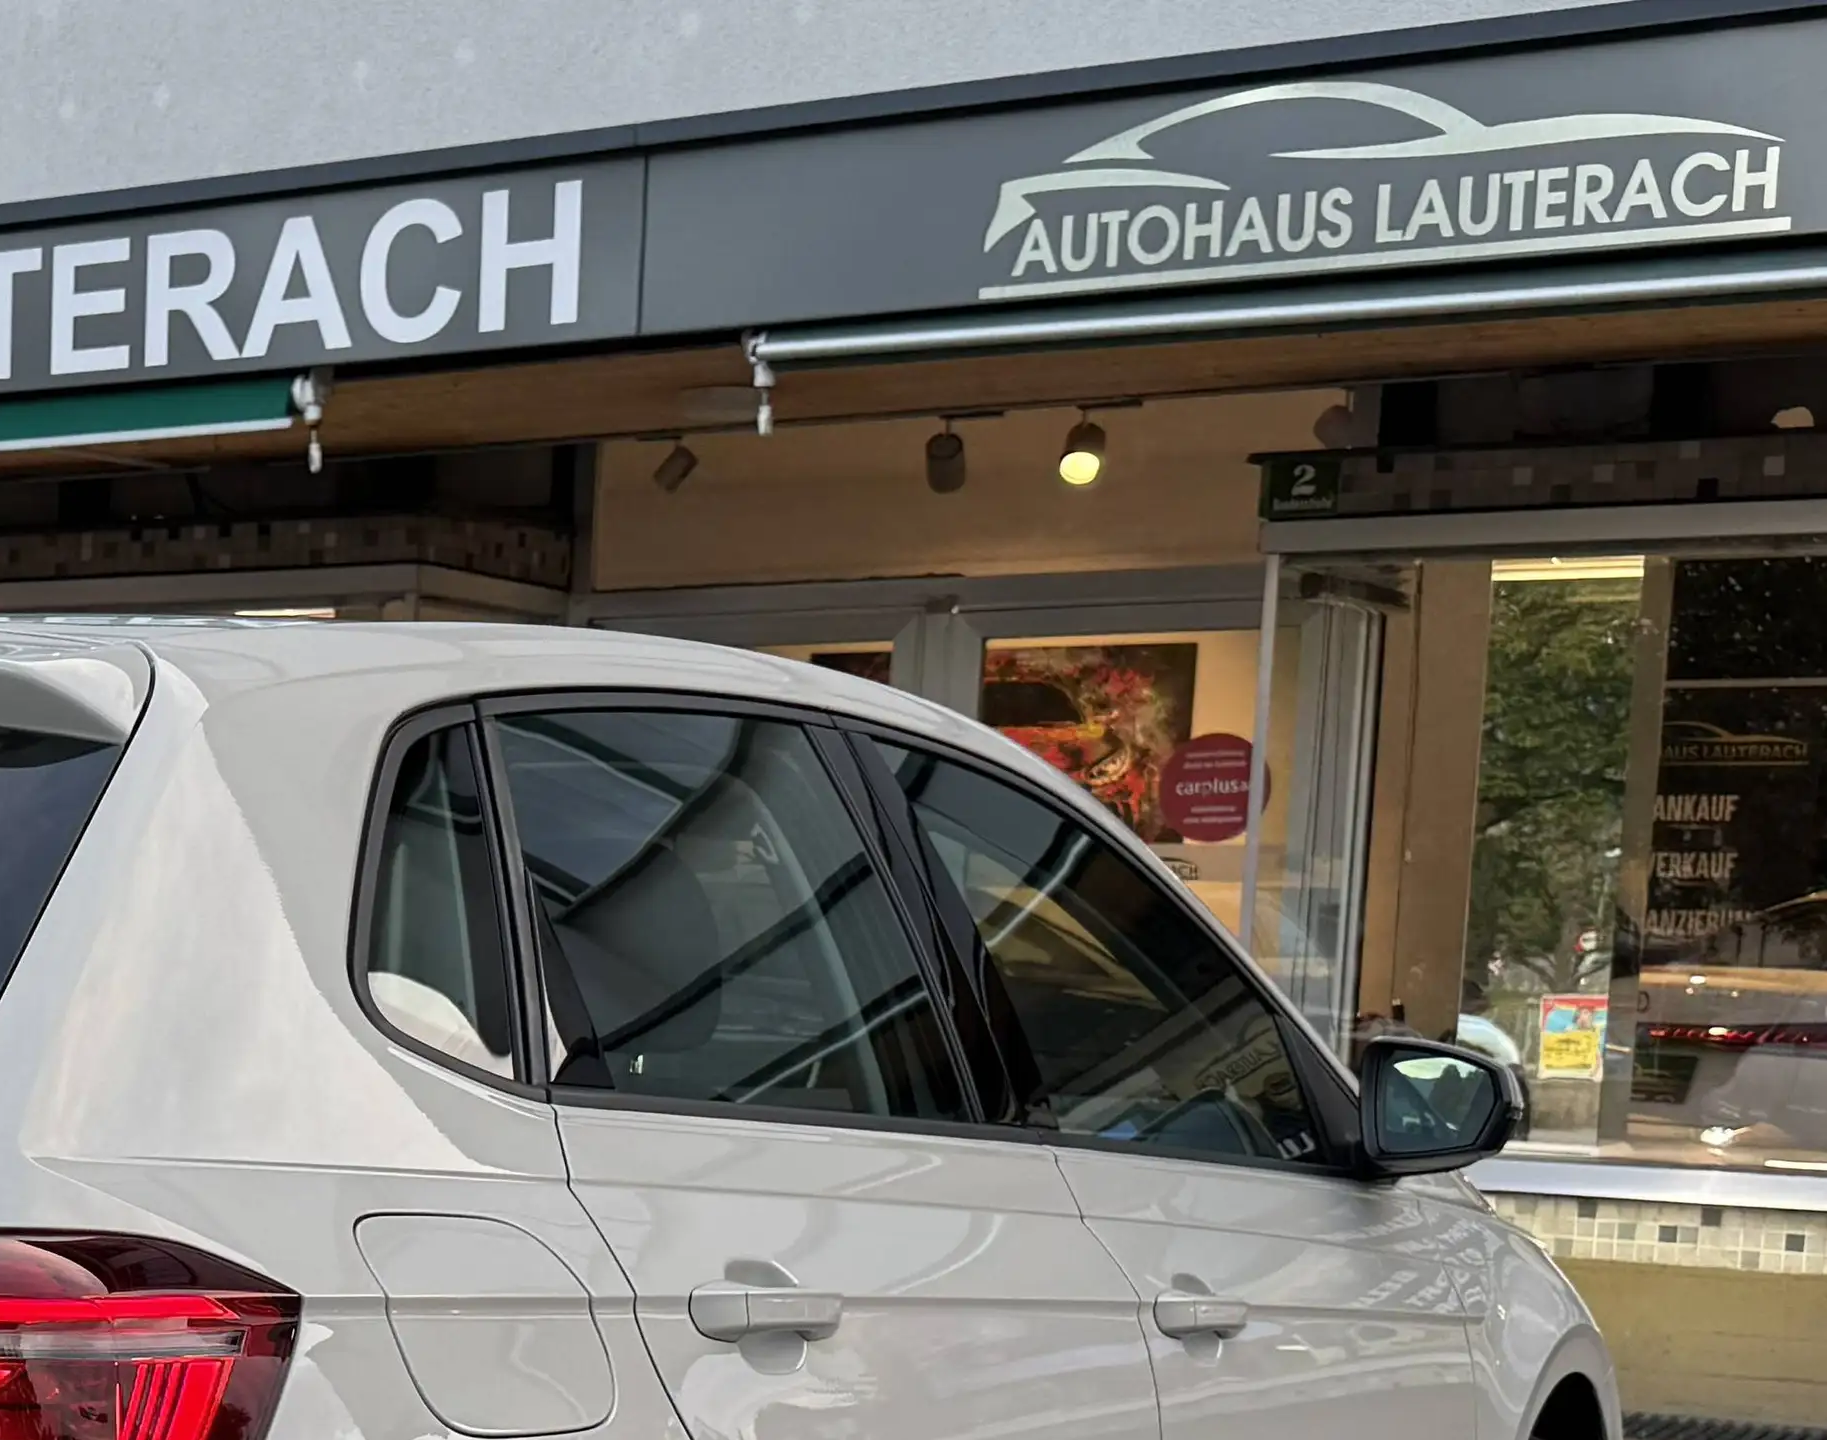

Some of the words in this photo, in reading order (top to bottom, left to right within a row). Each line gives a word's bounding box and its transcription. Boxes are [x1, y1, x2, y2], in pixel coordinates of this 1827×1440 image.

[1011, 186, 1353, 277] AUTOHAUS
[1375, 146, 1780, 244] LAUTERACH
[1291, 463, 1318, 497] 2
[1653, 794, 1740, 823] ANKAUF
